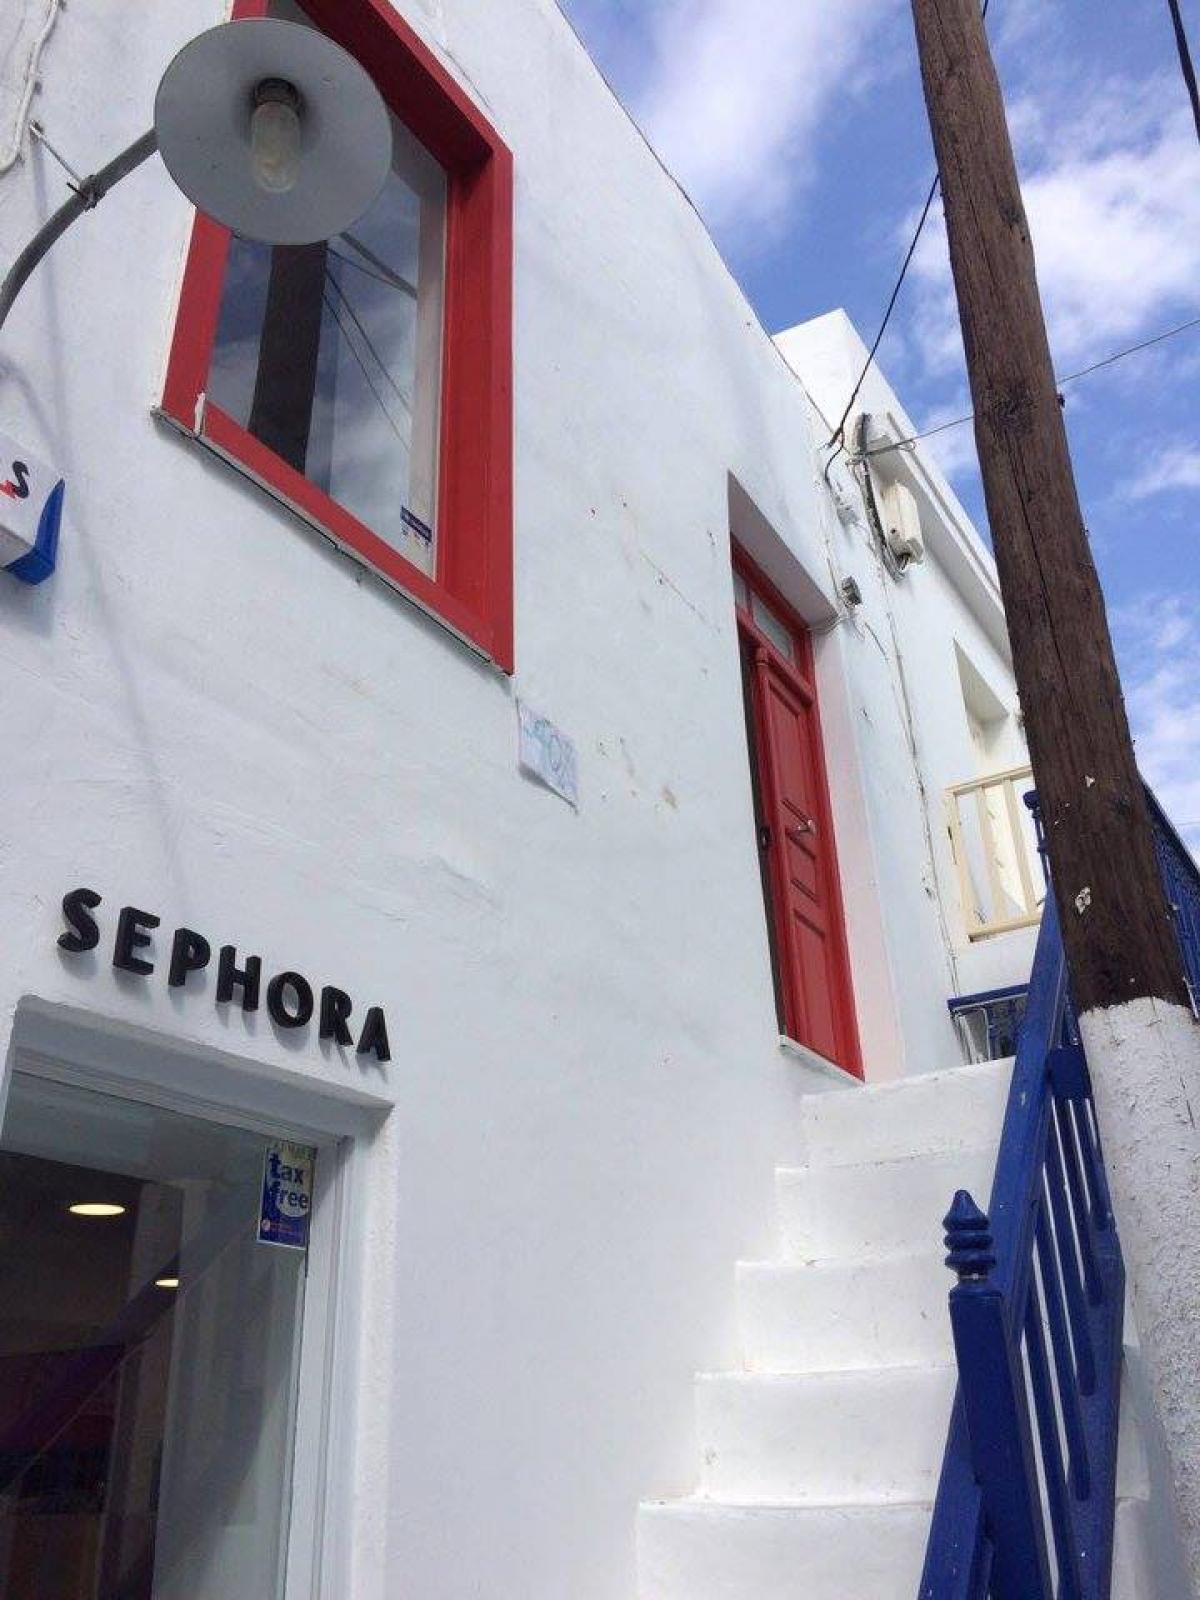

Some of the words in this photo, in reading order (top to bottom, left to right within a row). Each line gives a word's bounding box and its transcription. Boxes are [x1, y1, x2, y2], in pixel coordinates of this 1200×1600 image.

[56, 887, 391, 1061] SEPHORA
[268, 1152, 304, 1185] tax
[269, 1180, 309, 1210] free
